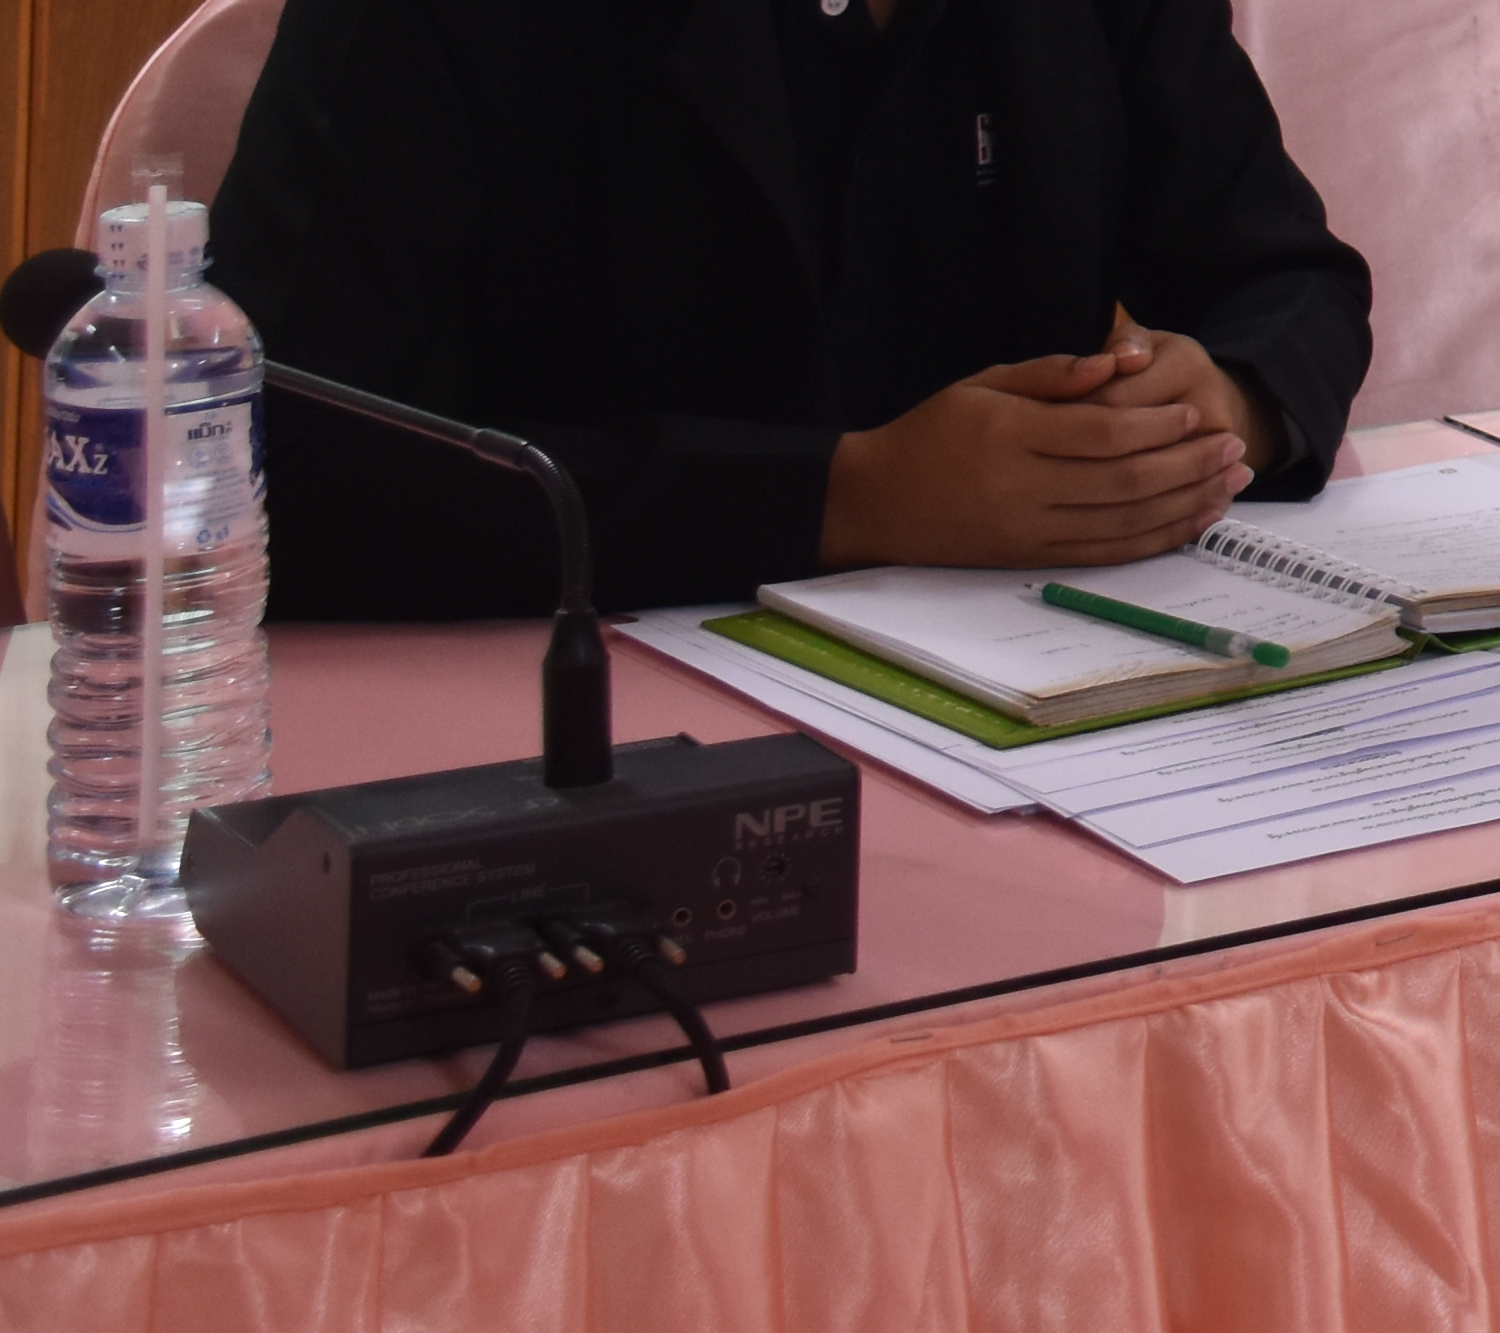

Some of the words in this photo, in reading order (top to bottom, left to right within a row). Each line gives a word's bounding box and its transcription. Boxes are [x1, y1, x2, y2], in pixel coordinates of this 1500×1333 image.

[735, 796, 844, 841] NPE
[369, 872, 473, 902] CONFERENCE
[475, 861, 538, 883] SYSTEM
[370, 858, 483, 886] PROFESSIONAL
[511, 884, 549, 904] LINE
